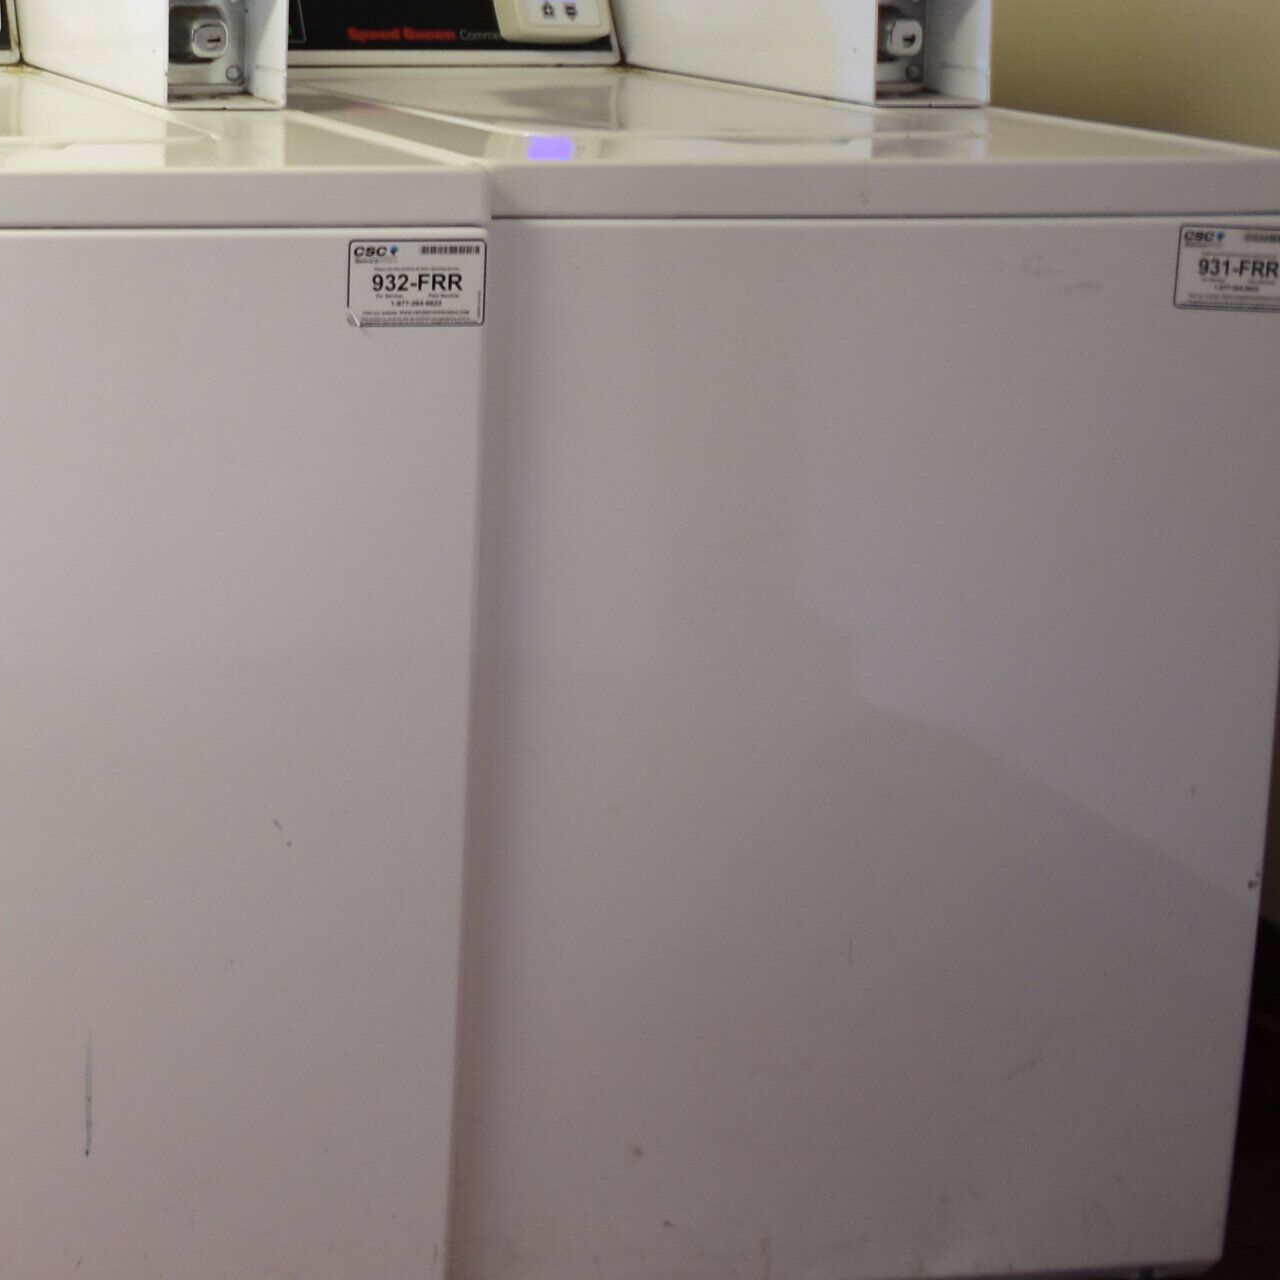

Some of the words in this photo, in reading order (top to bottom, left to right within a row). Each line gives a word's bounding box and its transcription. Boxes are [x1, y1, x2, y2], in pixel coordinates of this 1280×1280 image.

[348, 27, 400, 43] Speed
[404, 27, 457, 40] Queen
[460, 29, 499, 41] Comme
[354, 246, 387, 257] CSC
[1199, 258, 1279, 278] 931-FRR
[372, 274, 462, 291] 932-FRR
